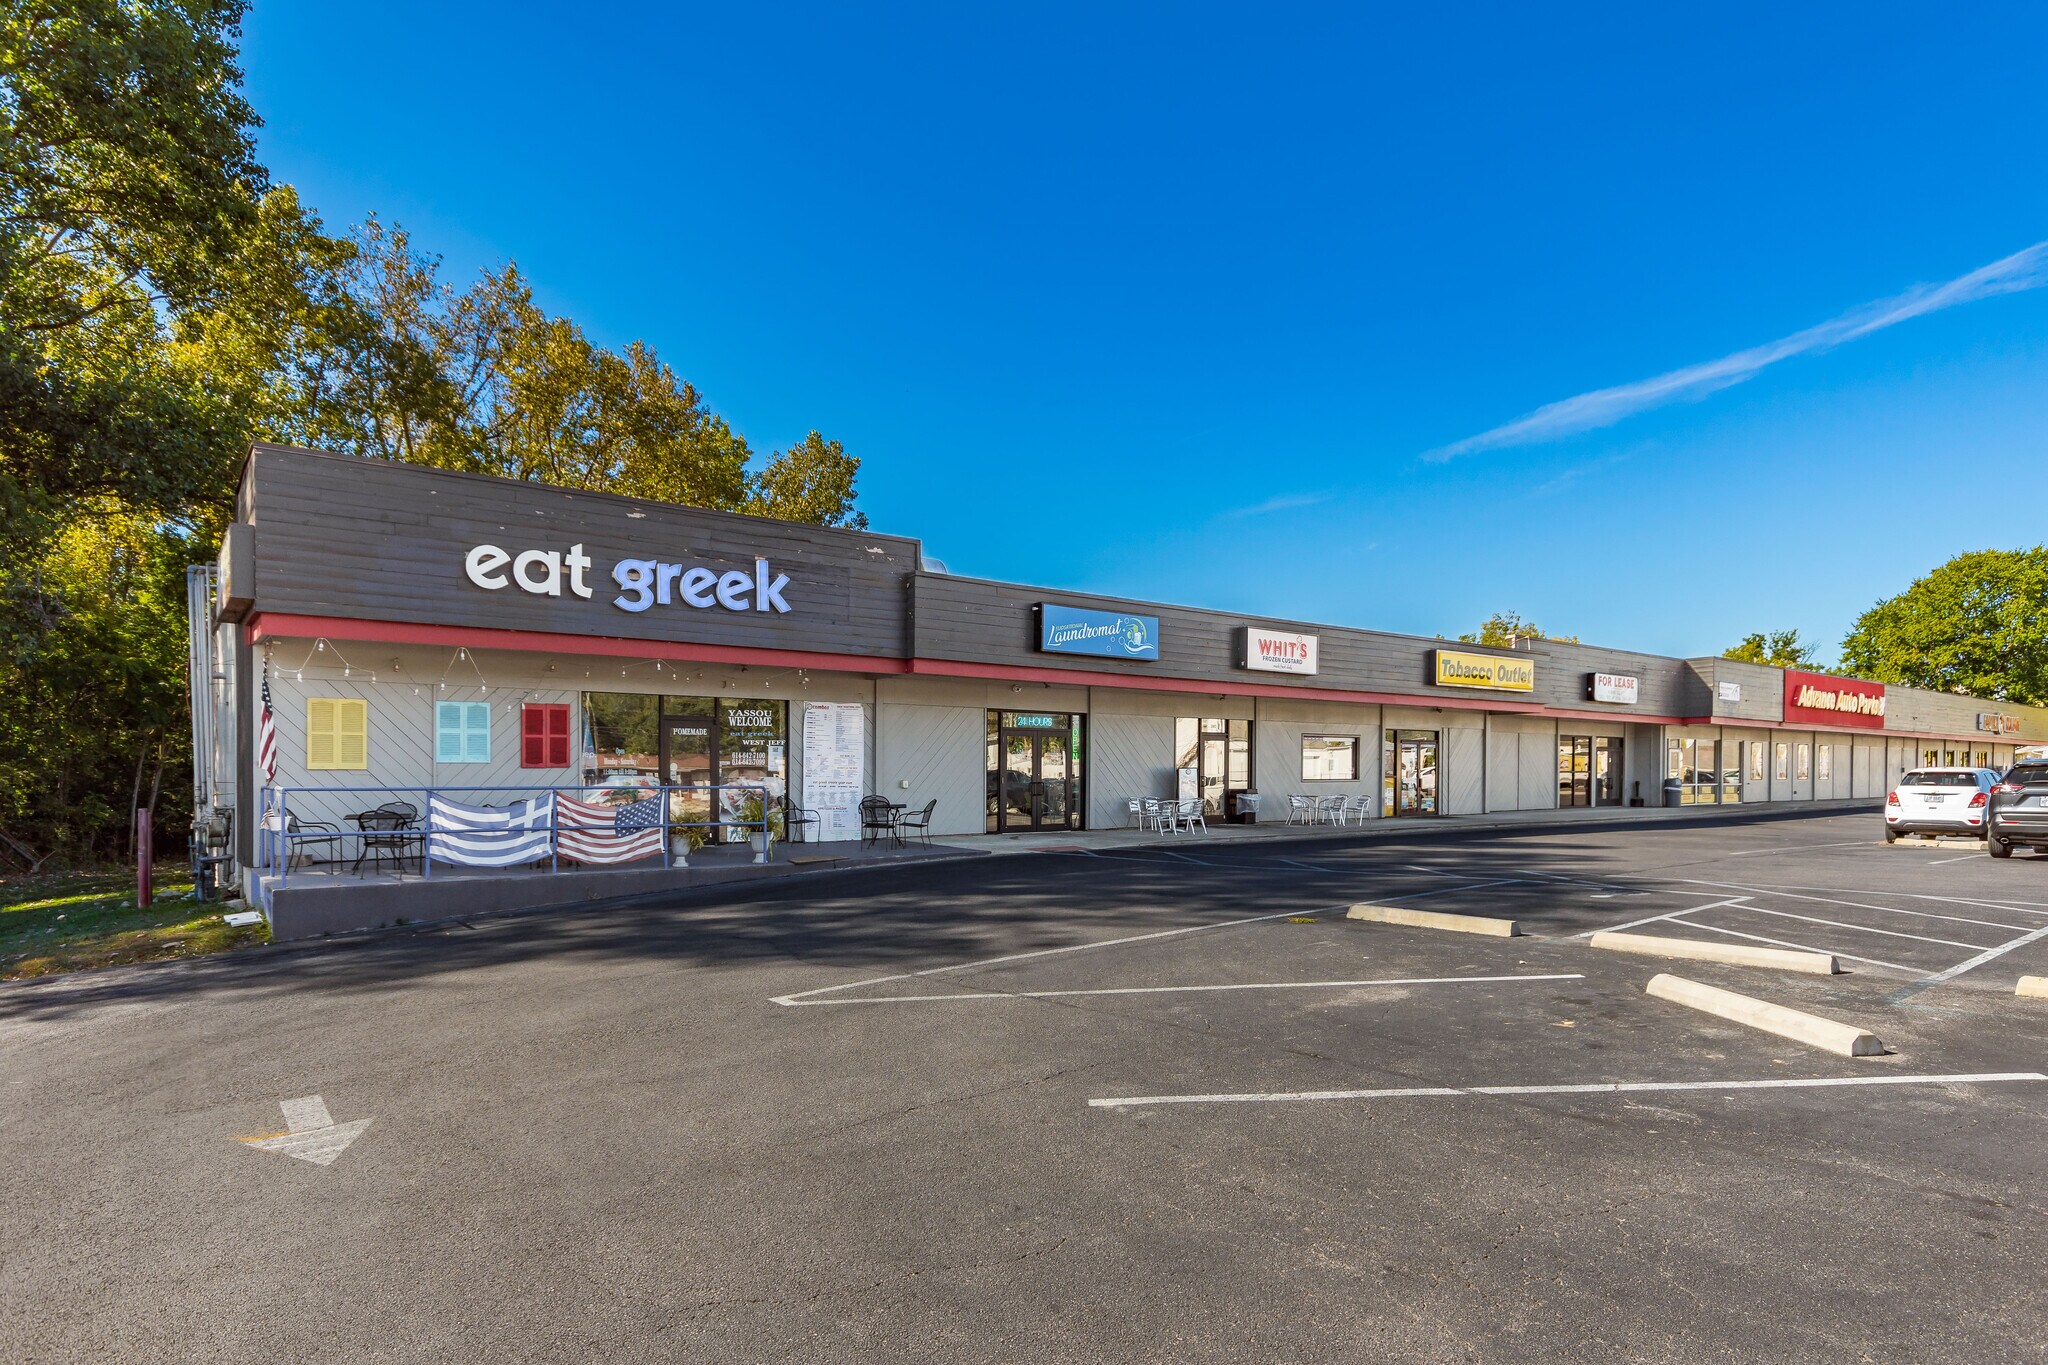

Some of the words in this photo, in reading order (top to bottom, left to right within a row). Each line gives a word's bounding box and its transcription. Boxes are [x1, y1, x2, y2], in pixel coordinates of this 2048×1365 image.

[465, 543, 593, 598] eat
[612, 558, 792, 613] greek
[1047, 618, 1123, 646] Laundromat
[1258, 638, 1307, 658] WHIT'S
[1262, 655, 1281, 663] FROZEN
[1281, 657, 1303, 665] CUSTARD
[1442, 659, 1493, 680] Tobacco
[1497, 664, 1532, 684] Outlet
[1598, 675, 1612, 687] FOR
[1614, 677, 1635, 689] LEASE
[1797, 684, 1836, 710] Advance
[1835, 689, 1857, 713] Auto
[1857, 692, 1880, 716] Parts
[728, 709, 772, 717] YASSOU
[728, 717, 772, 727] WELCOME
[1017, 716, 1026, 726] 24
[1028, 717, 1053, 727] HOURS
[747, 730, 774, 738] greek
